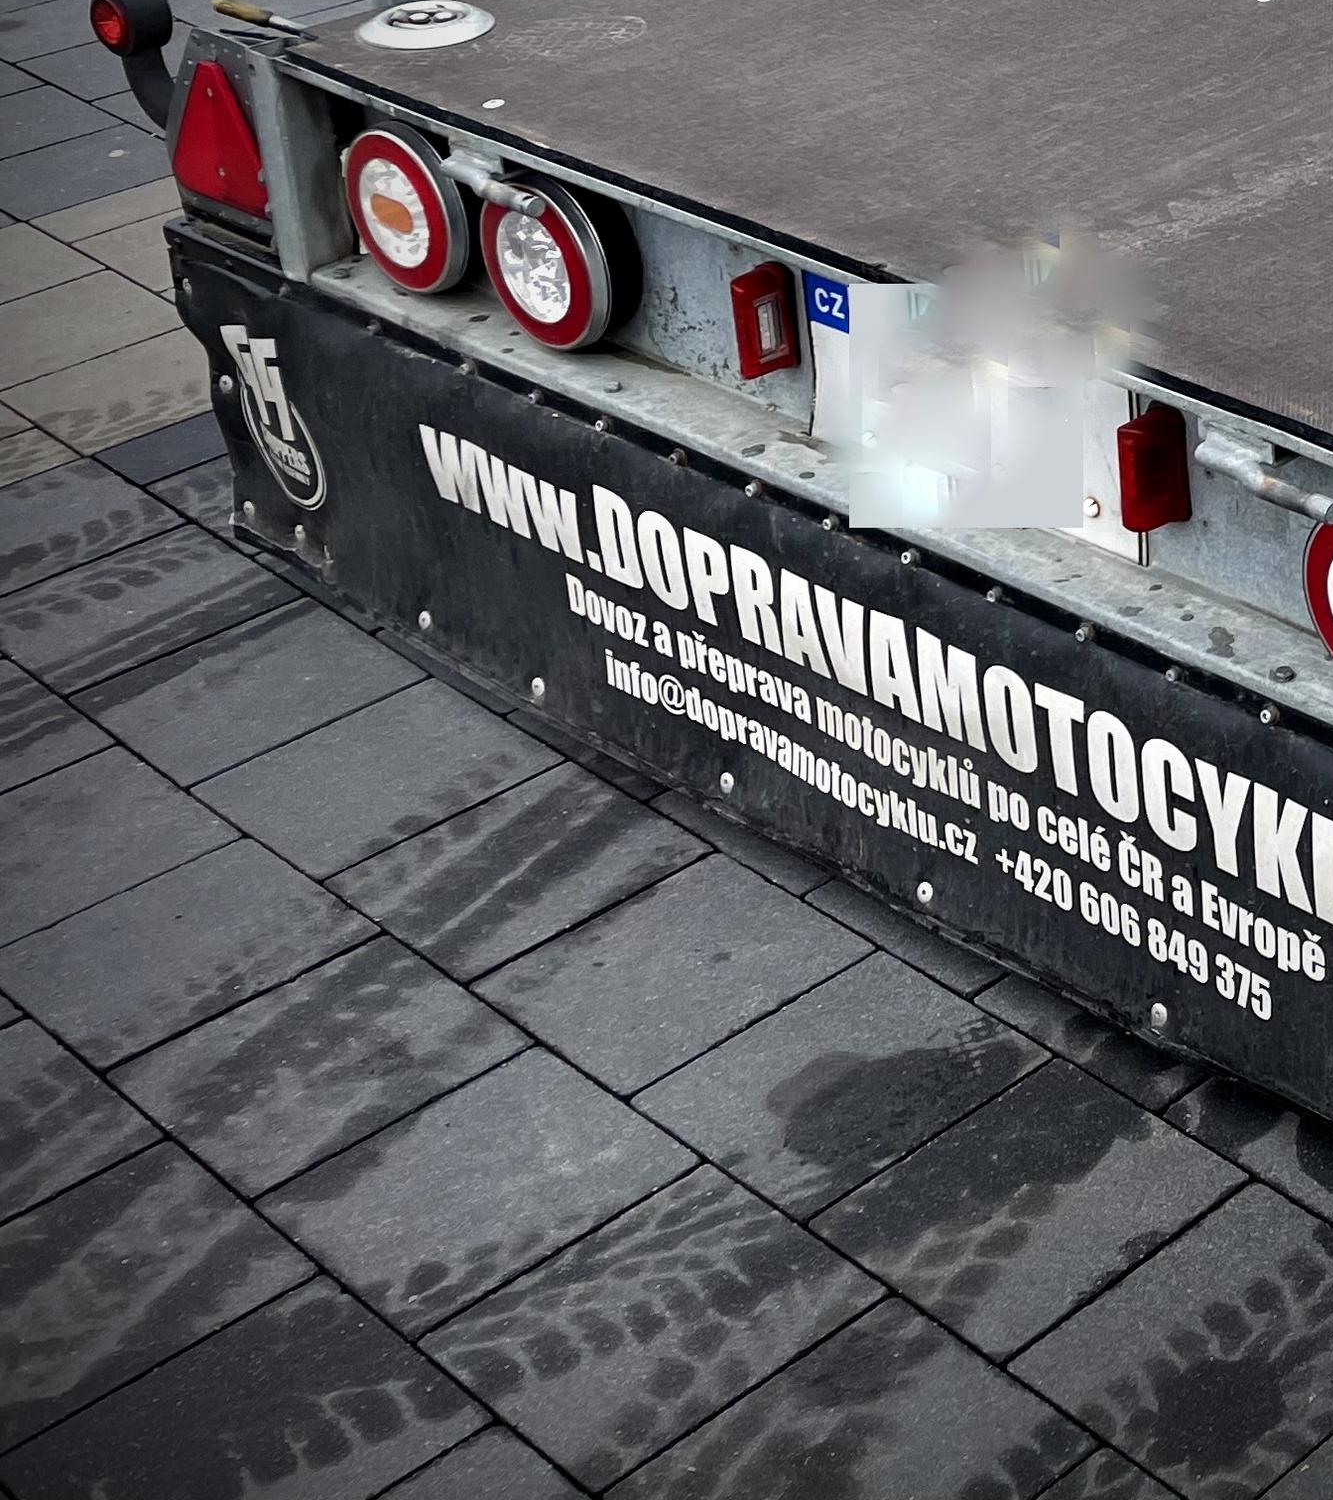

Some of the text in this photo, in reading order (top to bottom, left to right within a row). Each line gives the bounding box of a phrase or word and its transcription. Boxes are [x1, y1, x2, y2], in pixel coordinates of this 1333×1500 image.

[813, 286, 846, 320] CZ
[565, 572, 1327, 982] Dovoz a přeprava motocyklů po celé ČR a Evropě
[605, 648, 1273, 1021] info@dopravamotocyklu.cz +420 606 849 375
